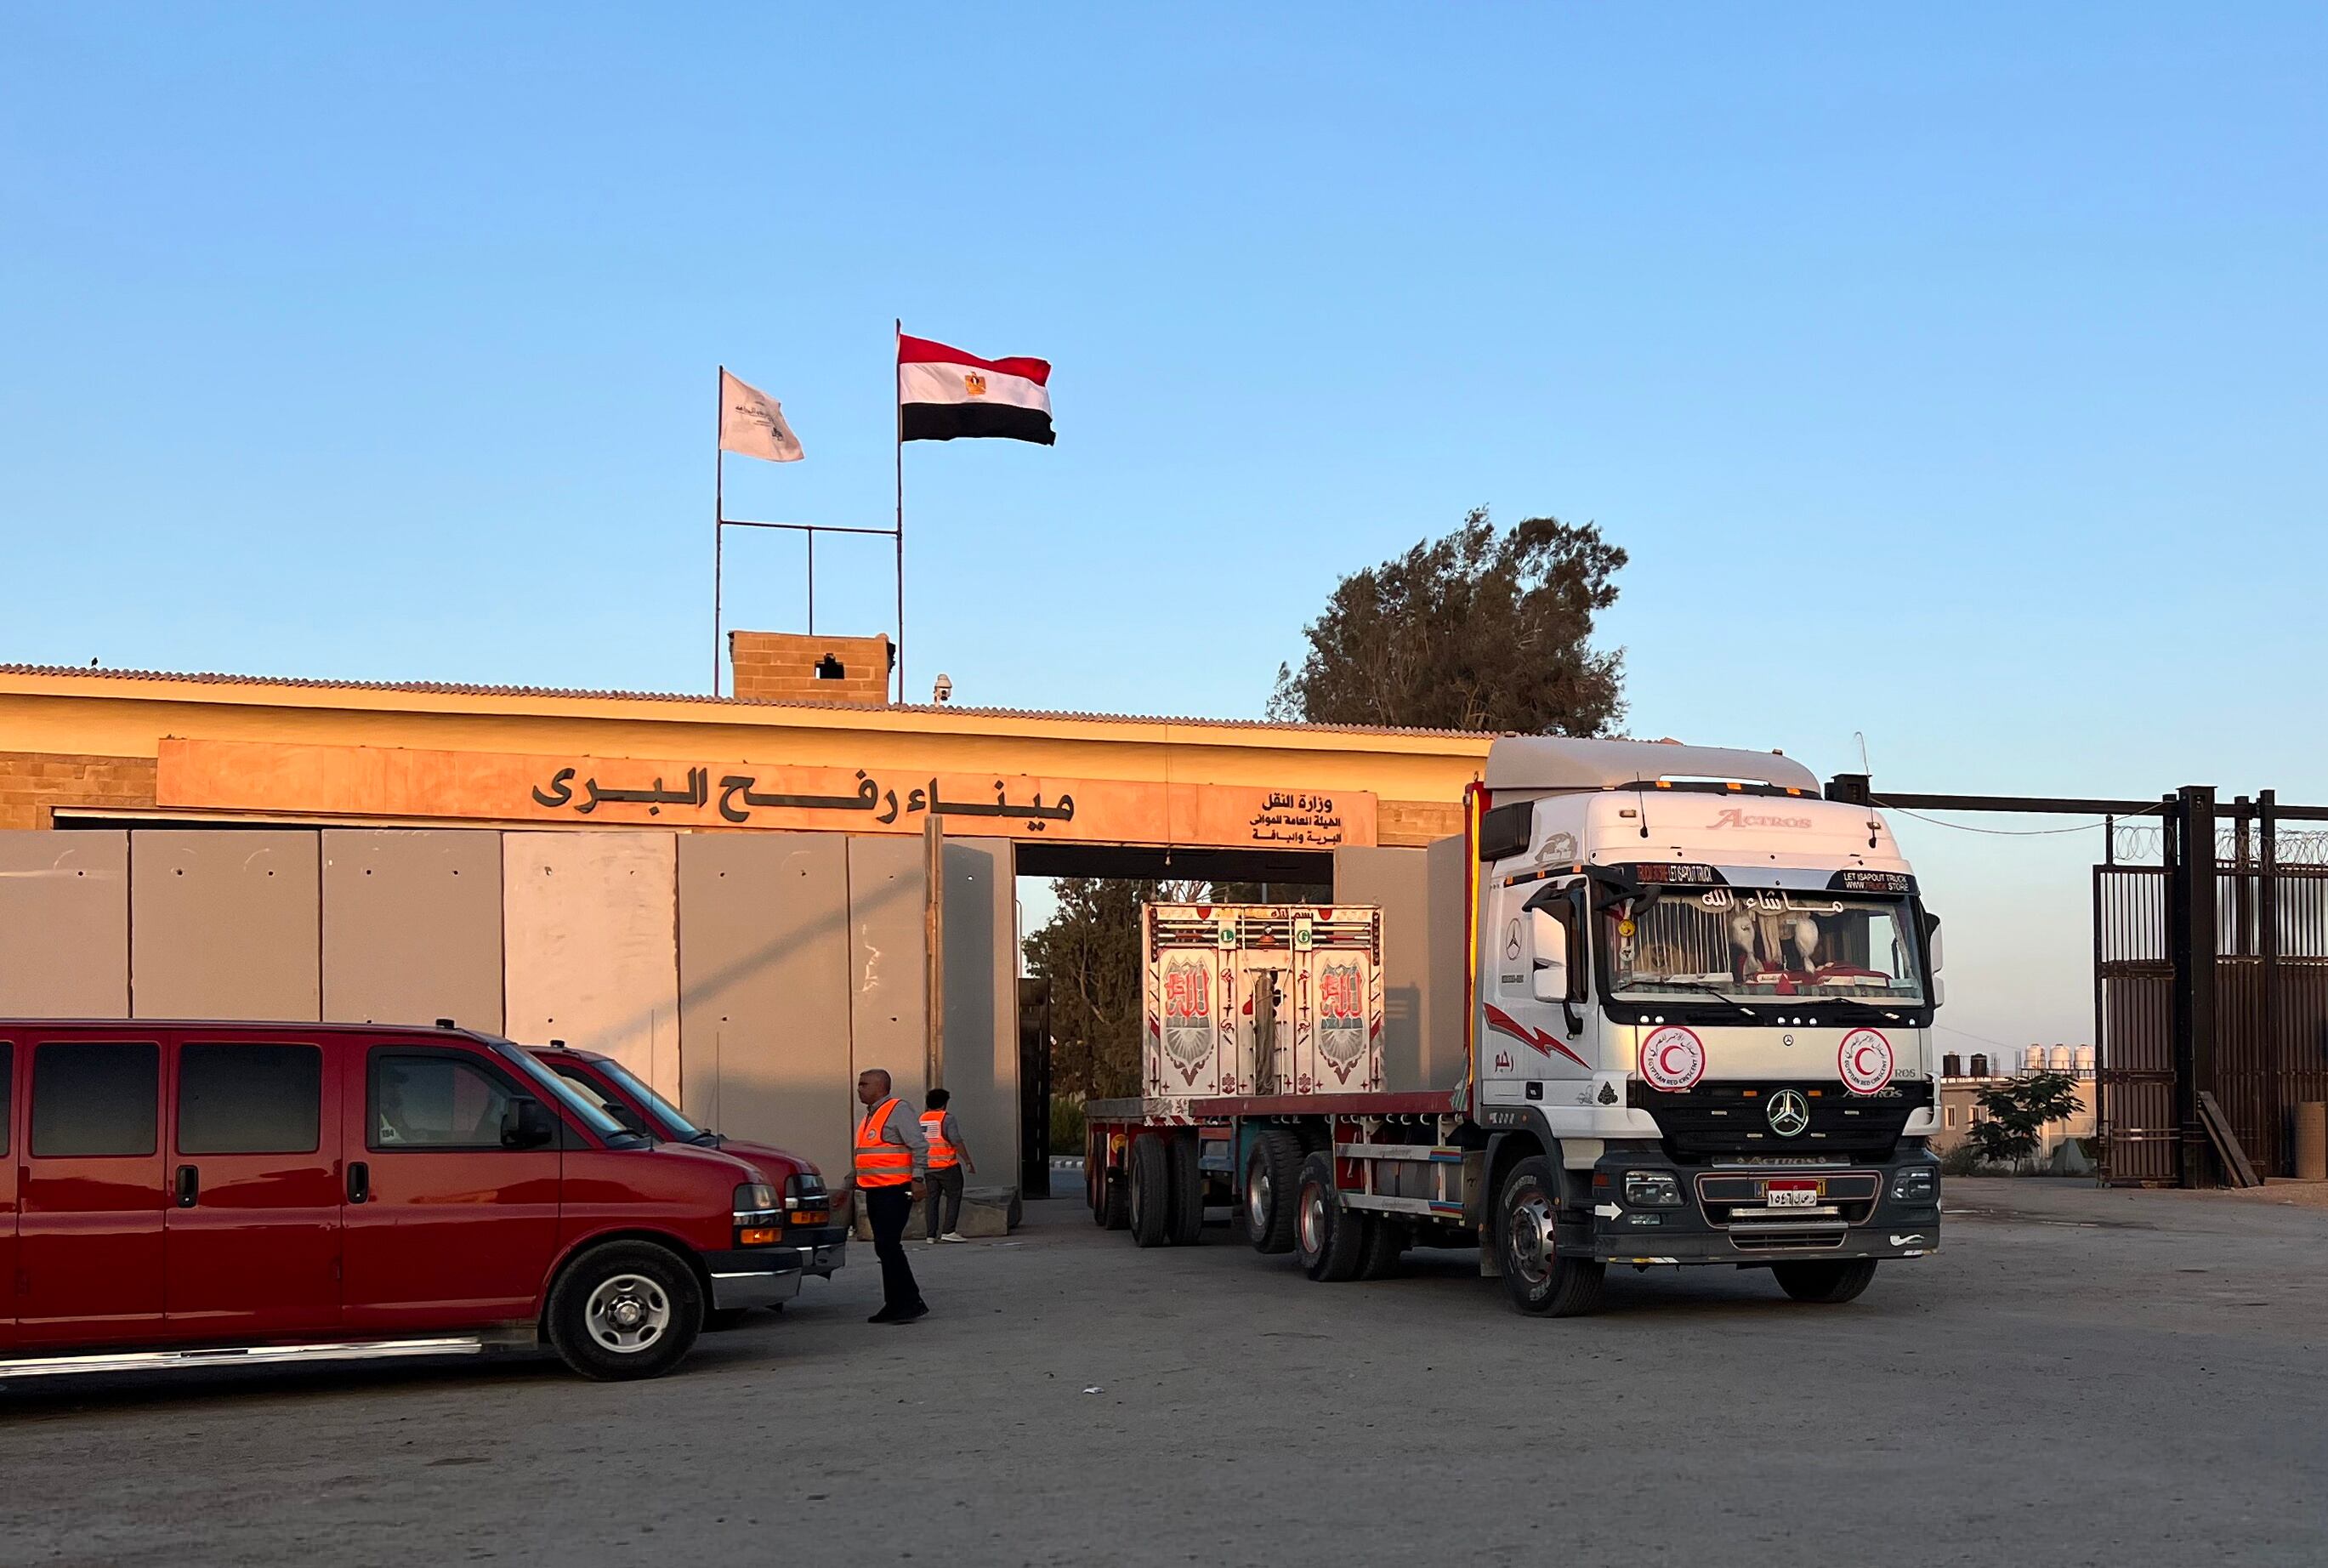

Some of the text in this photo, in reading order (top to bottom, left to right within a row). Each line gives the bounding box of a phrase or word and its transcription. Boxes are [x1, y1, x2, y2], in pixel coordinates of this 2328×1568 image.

[718, 769, 898, 822] رفح
[907, 778, 1075, 831] ميناء
[1262, 793, 1333, 814] وزارة النقل
[1285, 815, 1312, 826] العامة
[1314, 815, 1341, 829] الهيئة
[1307, 830, 1342, 845] البرية
[1843, 872, 1856, 881] LET
[1886, 874, 1907, 883] TRUCK
[1888, 883, 1910, 891] STORE
[1701, 889, 1735, 906] الله
[1648, 1058, 1667, 1083] EGYPTIAN
[1678, 1060, 1697, 1084] CRESCENT
[1769, 1193, 1791, 1204] ١٥٤٦
